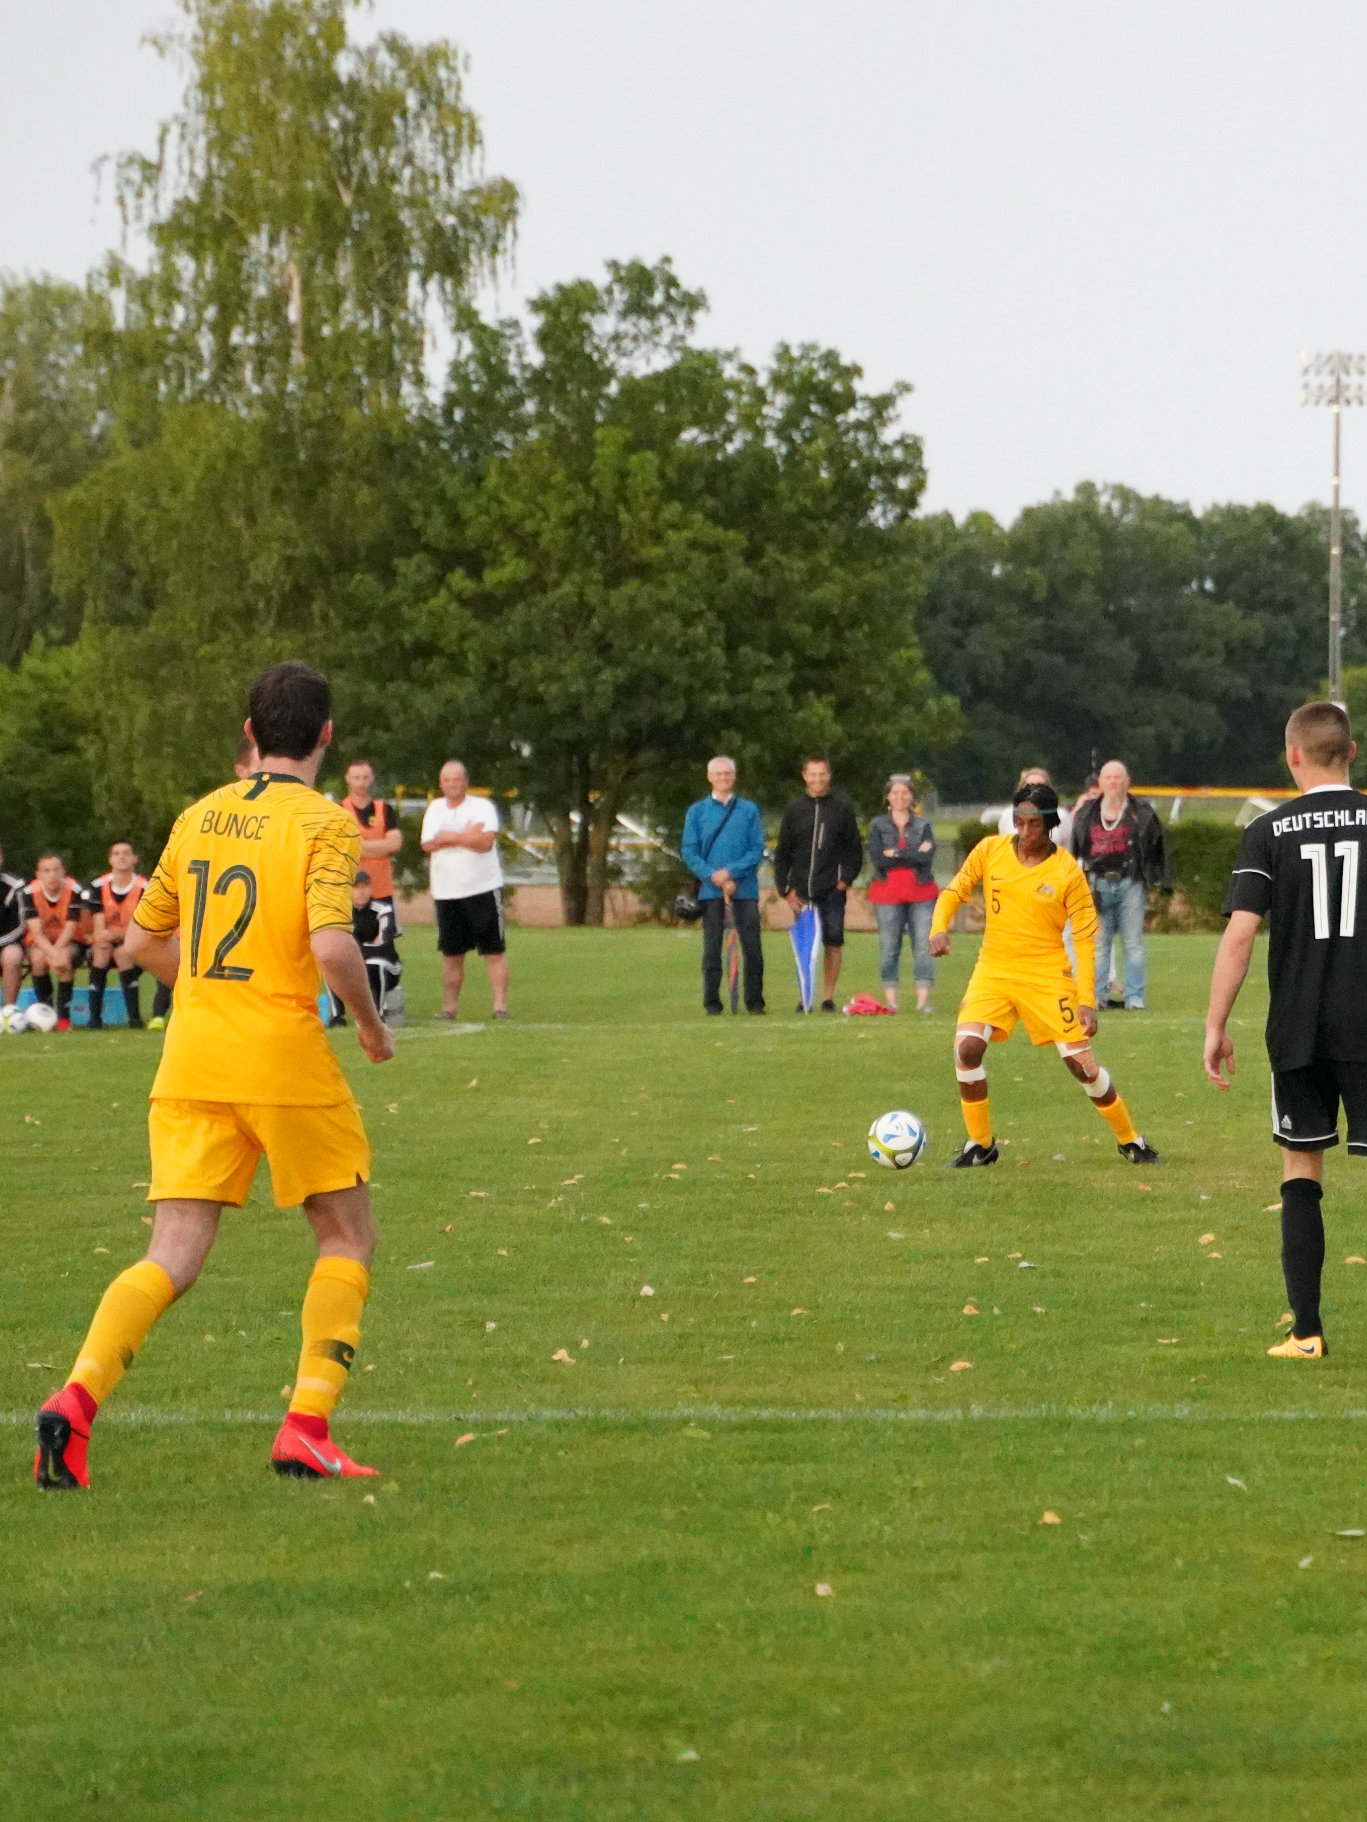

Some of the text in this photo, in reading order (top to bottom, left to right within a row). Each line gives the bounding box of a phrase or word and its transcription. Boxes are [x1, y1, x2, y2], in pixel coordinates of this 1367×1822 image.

[200, 810, 270, 841] BUNCE
[991, 889, 1001, 914] 5
[1300, 840, 1359, 939] 11
[187, 859, 257, 982] 12
[1058, 997, 1075, 1024] 5
